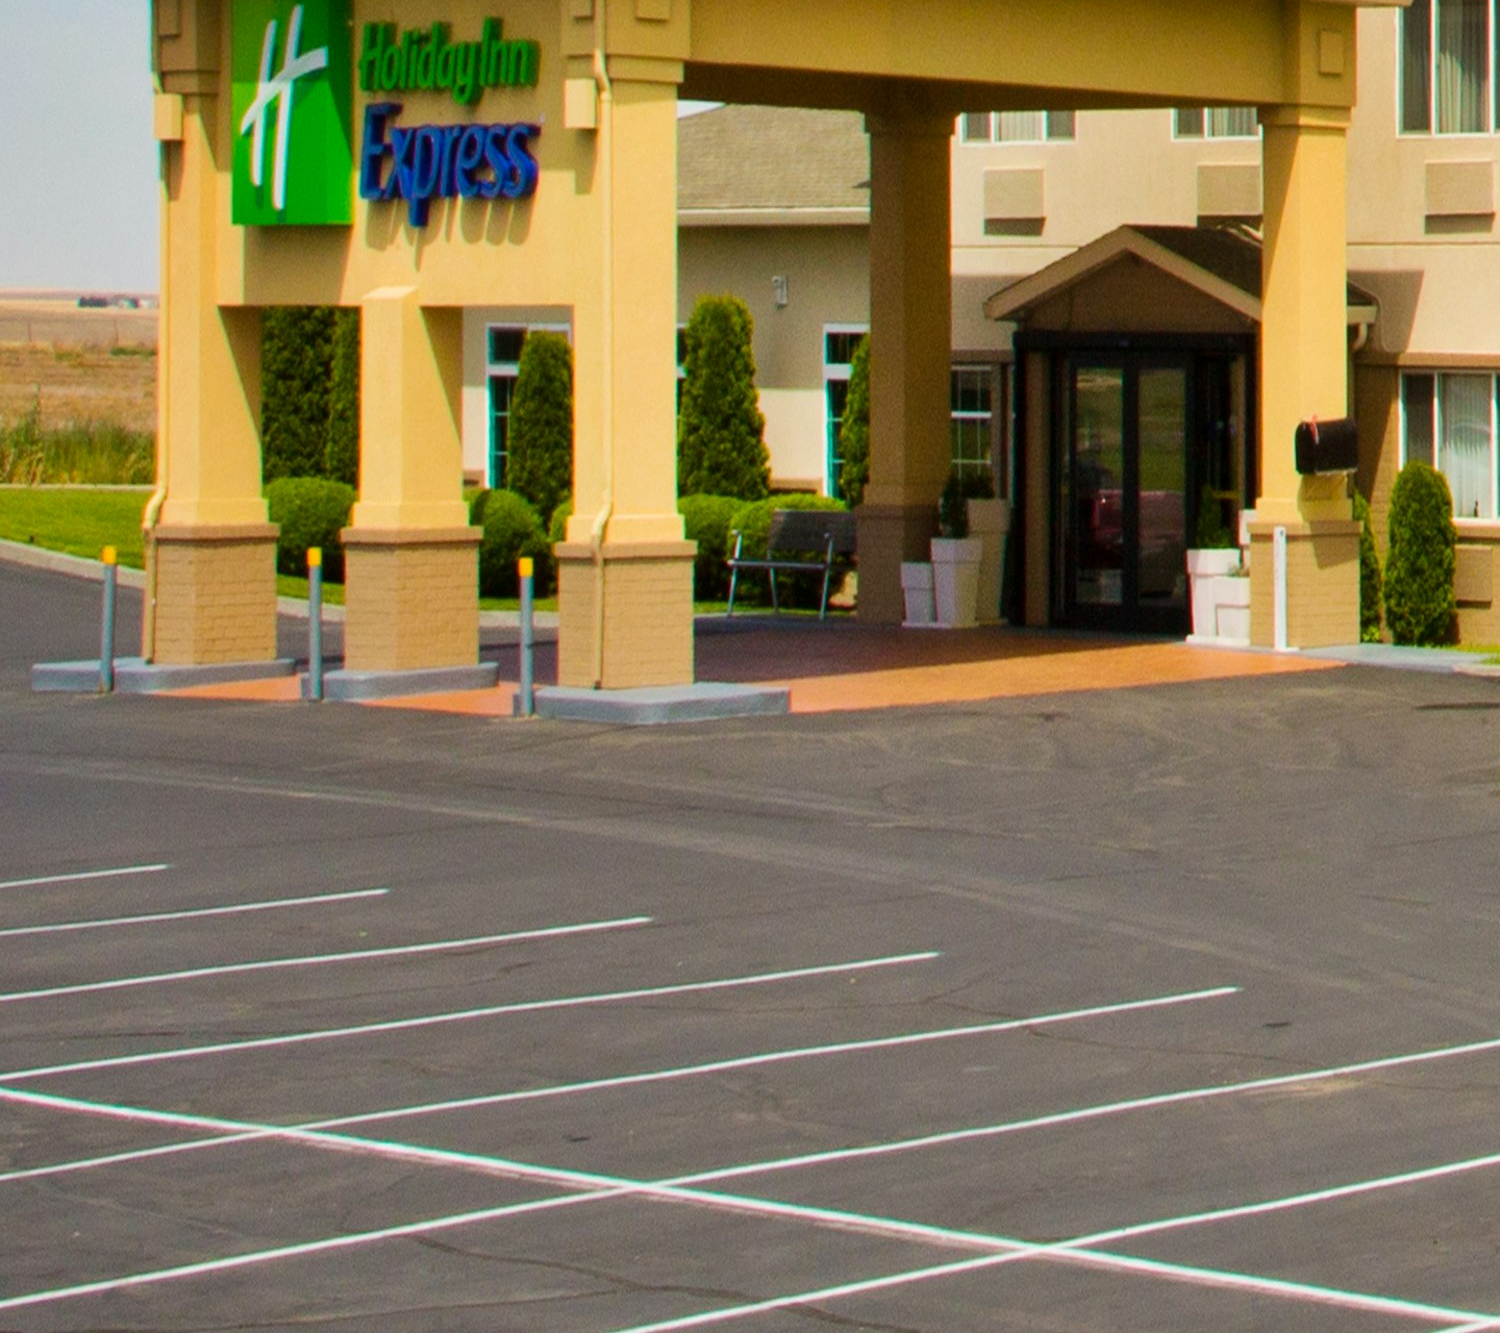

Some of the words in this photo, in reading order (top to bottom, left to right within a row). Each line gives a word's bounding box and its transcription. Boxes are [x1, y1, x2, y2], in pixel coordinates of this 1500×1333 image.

[358, 21, 482, 105] Holiday
[479, 16, 541, 89] Inn
[360, 103, 540, 227] Express
